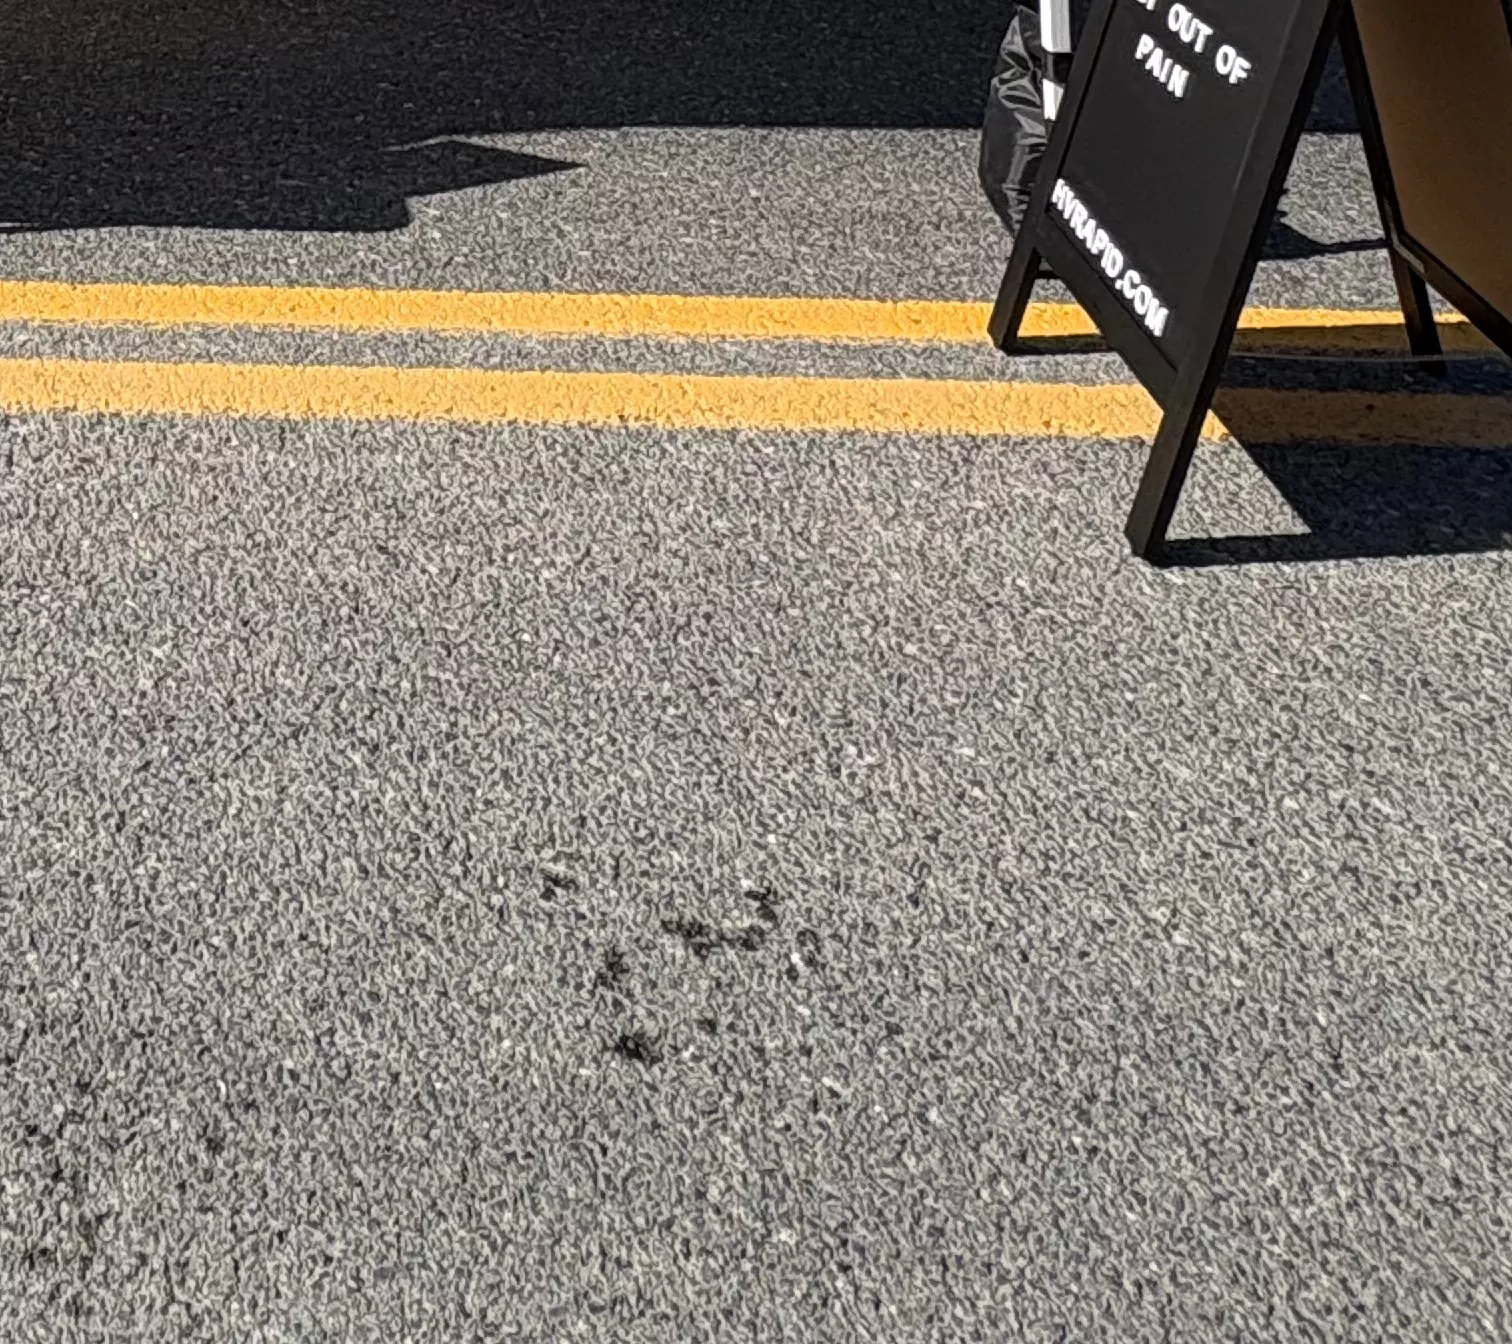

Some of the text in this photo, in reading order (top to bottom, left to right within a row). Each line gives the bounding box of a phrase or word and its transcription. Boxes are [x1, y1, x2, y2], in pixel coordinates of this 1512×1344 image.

[1136, 34, 1189, 99] PAIN
[1168, 3, 1214, 55] OUT
[1216, 42, 1252, 84] OF
[1050, 178, 1168, 338] HVRAPID.COM
